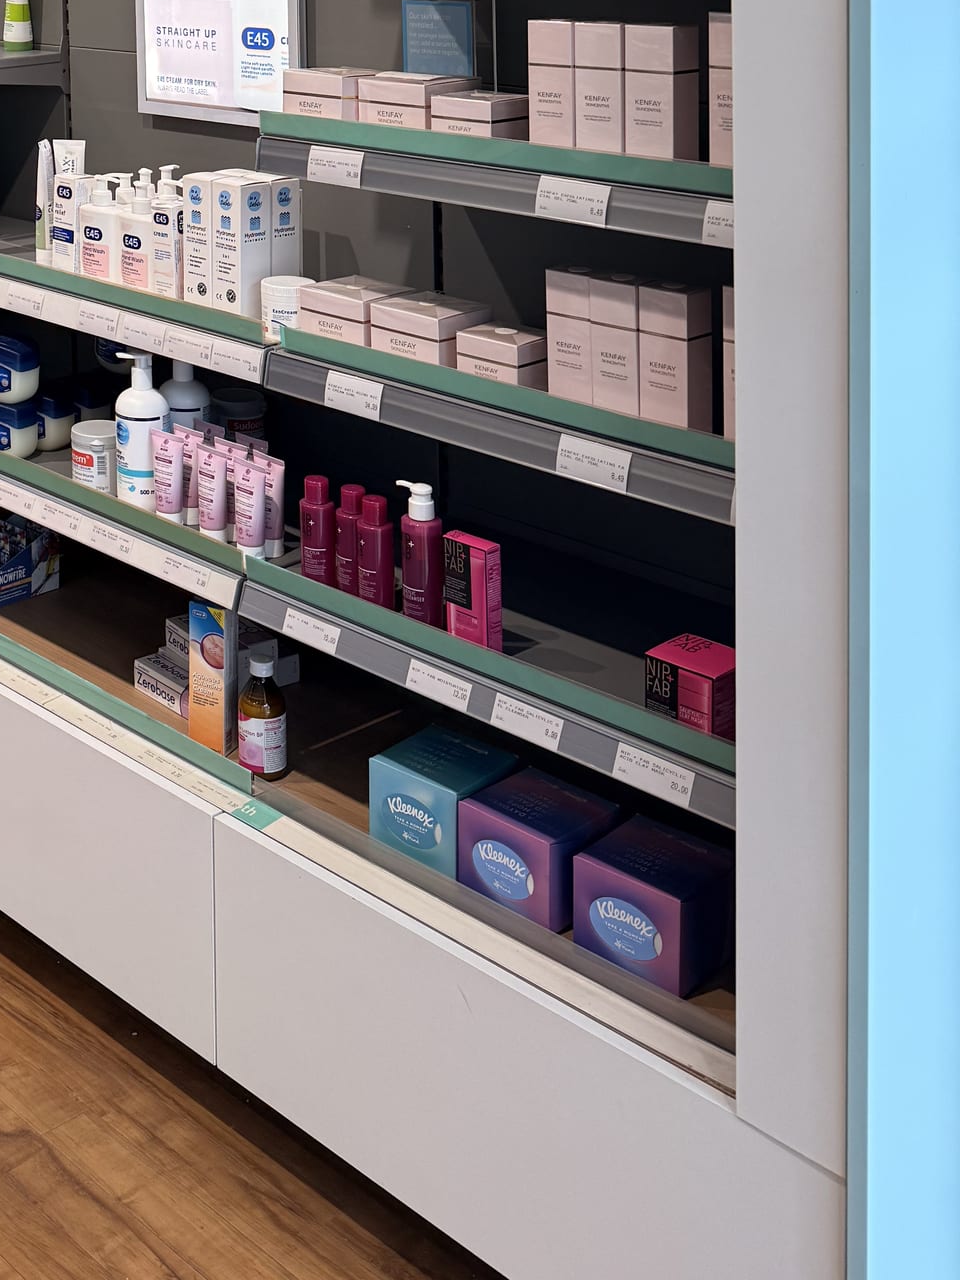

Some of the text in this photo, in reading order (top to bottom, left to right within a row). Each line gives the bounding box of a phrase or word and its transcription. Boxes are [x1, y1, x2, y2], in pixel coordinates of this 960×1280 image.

[156, 26, 217, 39] STRAIGHT UP
[156, 37, 217, 51] SKINCARE
[247, 31, 269, 47] E45
[537, 91, 562, 99] KENFAY
[716, 94, 733, 102] KEN
[299, 101, 323, 109] KENFAY
[635, 99, 662, 107] KENFAY
[377, 110, 403, 118] KENFAY
[448, 125, 472, 133] KENFAY
[58, 187, 70, 198] E45
[155, 214, 167, 224] E45
[85, 227, 100, 239] E45
[244, 231, 266, 239] Hydromol
[124, 237, 139, 248] E45
[318, 320, 343, 330] KENFAY
[390, 338, 417, 349] KENFAY
[556, 341, 581, 351] KENFAY
[600, 351, 627, 361] KENFAY
[474, 363, 499, 374] KENFAY
[649, 361, 676, 371] KENFAY
[444, 554, 464, 573] FAB
[168, 630, 189, 655] Zerob
[137, 671, 176, 705] Zerobase
[646, 674, 671, 698] FAB
[670, 781, 688, 795] 20.00
[387, 797, 434, 828] Kleenex
[478, 844, 526, 878] Kleenex
[596, 900, 654, 937] Kleenex
